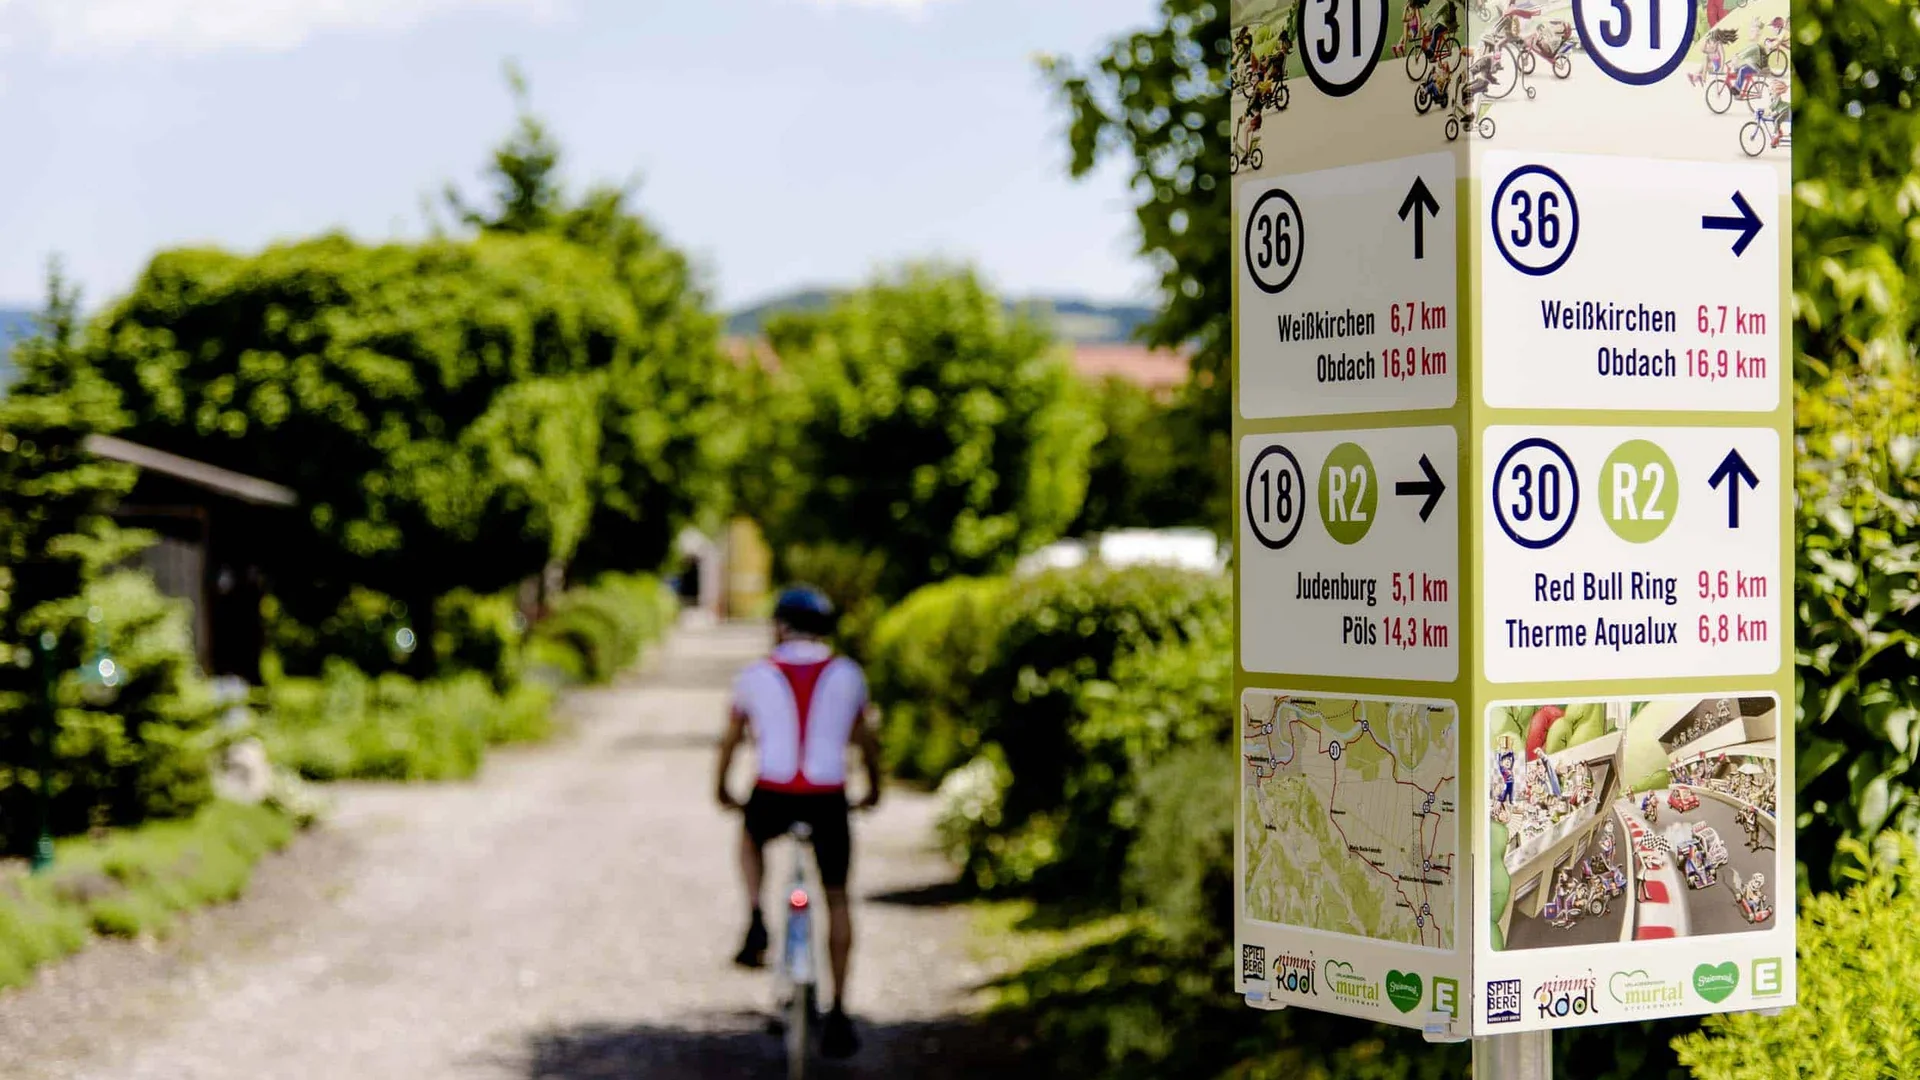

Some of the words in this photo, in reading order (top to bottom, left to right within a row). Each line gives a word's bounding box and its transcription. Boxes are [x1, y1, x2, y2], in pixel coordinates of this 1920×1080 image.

[1316, 0, 1361, 64] 31
[1599, 0, 1661, 49] 31
[1511, 190, 1560, 248] 36
[1257, 212, 1291, 268] 36
[1278, 309, 1375, 342] Weißkirchen
[1391, 303, 1415, 336] 6,7
[1421, 301, 1446, 330] km
[1541, 300, 1676, 332] Weißkirchen
[1697, 305, 1728, 338] 6,7
[1736, 306, 1766, 335] km
[1317, 351, 1375, 382] Obdach
[1382, 347, 1416, 381] 16,9
[1422, 347, 1446, 375] km
[1597, 347, 1676, 377] Obdach
[1686, 349, 1728, 382] 16,9
[1736, 350, 1766, 378] km
[1260, 469, 1292, 523] 18
[1328, 465, 1367, 522] R2
[1512, 464, 1560, 521] 30
[1613, 462, 1665, 520] R2
[1296, 572, 1377, 606] Judenburg
[1392, 572, 1415, 606] 5,1
[1423, 572, 1448, 602] km
[1535, 572, 1575, 602] Red
[1583, 572, 1622, 601] Bull
[1631, 571, 1677, 605] Ring
[1698, 570, 1728, 603] 9,6
[1737, 570, 1767, 599] km
[1343, 616, 1377, 645] Pöls
[1383, 617, 1417, 650] 14,3
[1423, 618, 1448, 647] km
[1506, 618, 1587, 648] Therme
[1595, 616, 1678, 651] Aqualux
[1698, 614, 1728, 647] 6,8
[1737, 614, 1767, 642] km
[1243, 946, 1264, 960] SPIEL
[1244, 960, 1263, 973] BERG
[1335, 981, 1379, 1001] murtal
[1488, 981, 1520, 996] SPIEL
[1488, 995, 1517, 1010] BERG
[1625, 980, 1684, 1005] murtal
